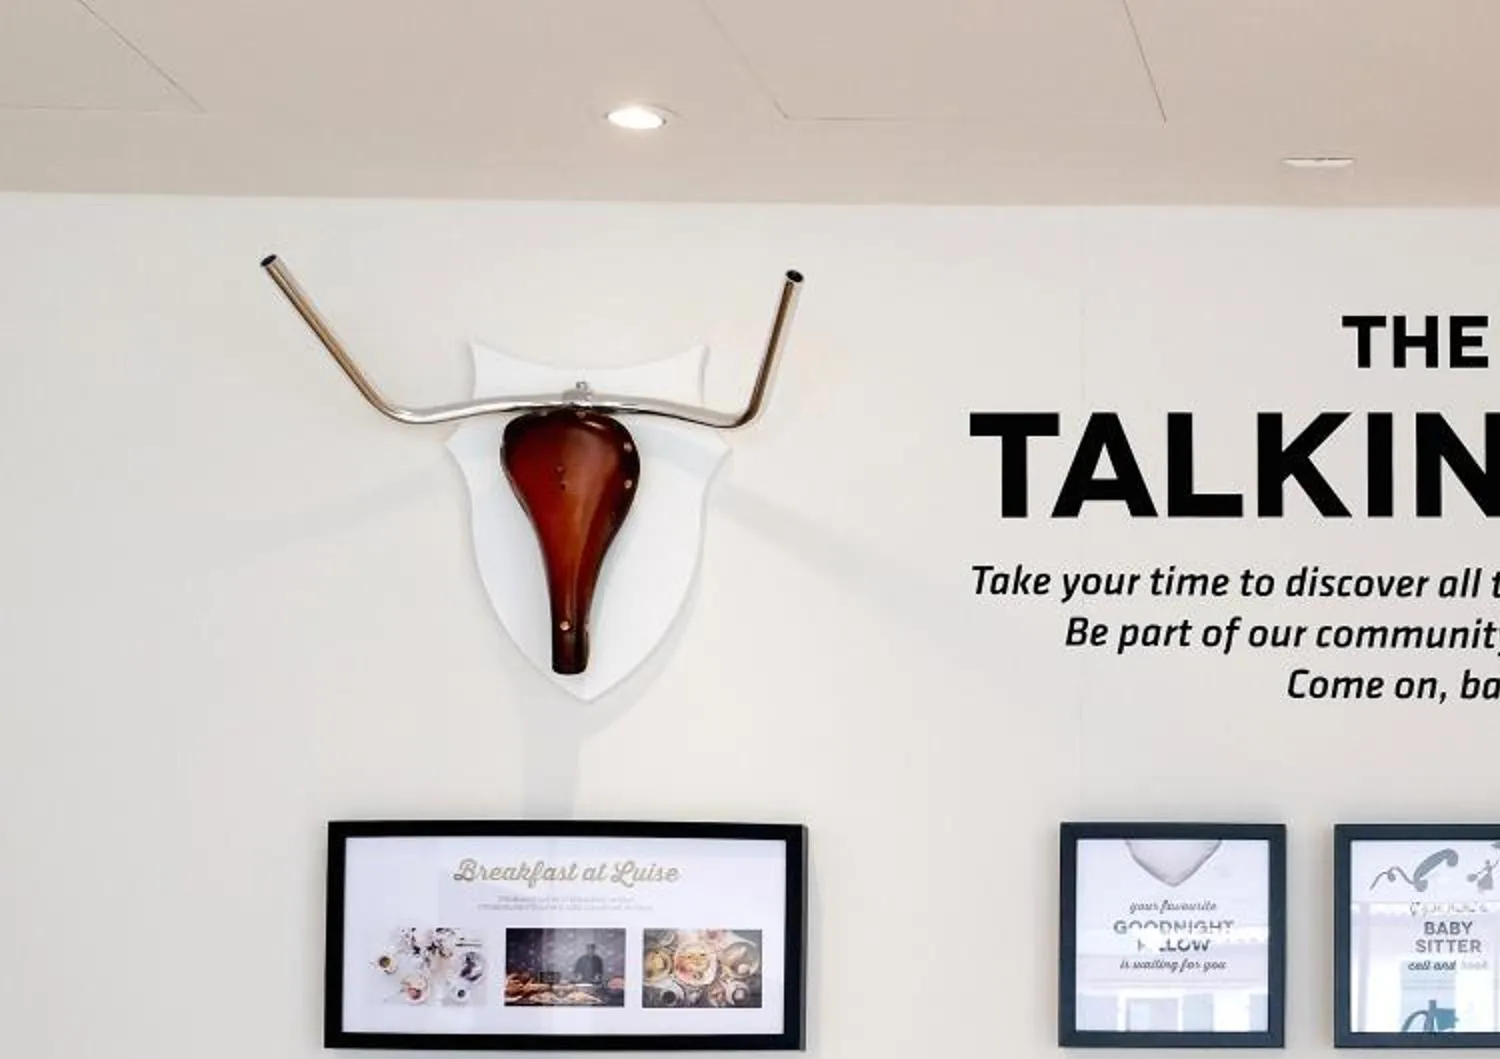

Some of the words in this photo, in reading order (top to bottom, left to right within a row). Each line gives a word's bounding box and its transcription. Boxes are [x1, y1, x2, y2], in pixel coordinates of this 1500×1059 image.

[1341, 314, 1489, 369] THE
[971, 563, 1052, 596] Take
[1060, 573, 1142, 604] your
[1149, 565, 1230, 597] time
[1239, 568, 1275, 597] to
[1285, 565, 1431, 598] discover
[1437, 567, 1483, 599] all
[1065, 616, 1109, 647] Be
[1116, 619, 1193, 656] part
[1201, 615, 1243, 656] of
[1247, 625, 1309, 648] our
[1287, 668, 1385, 699] Come
[1394, 677, 1447, 705] on,
[451, 857, 579, 889] Breakfast
[580, 860, 609, 883] at
[609, 860, 682, 889] Luise
[1414, 938, 1482, 954] SITTER
[1423, 920, 1474, 936] BABY
